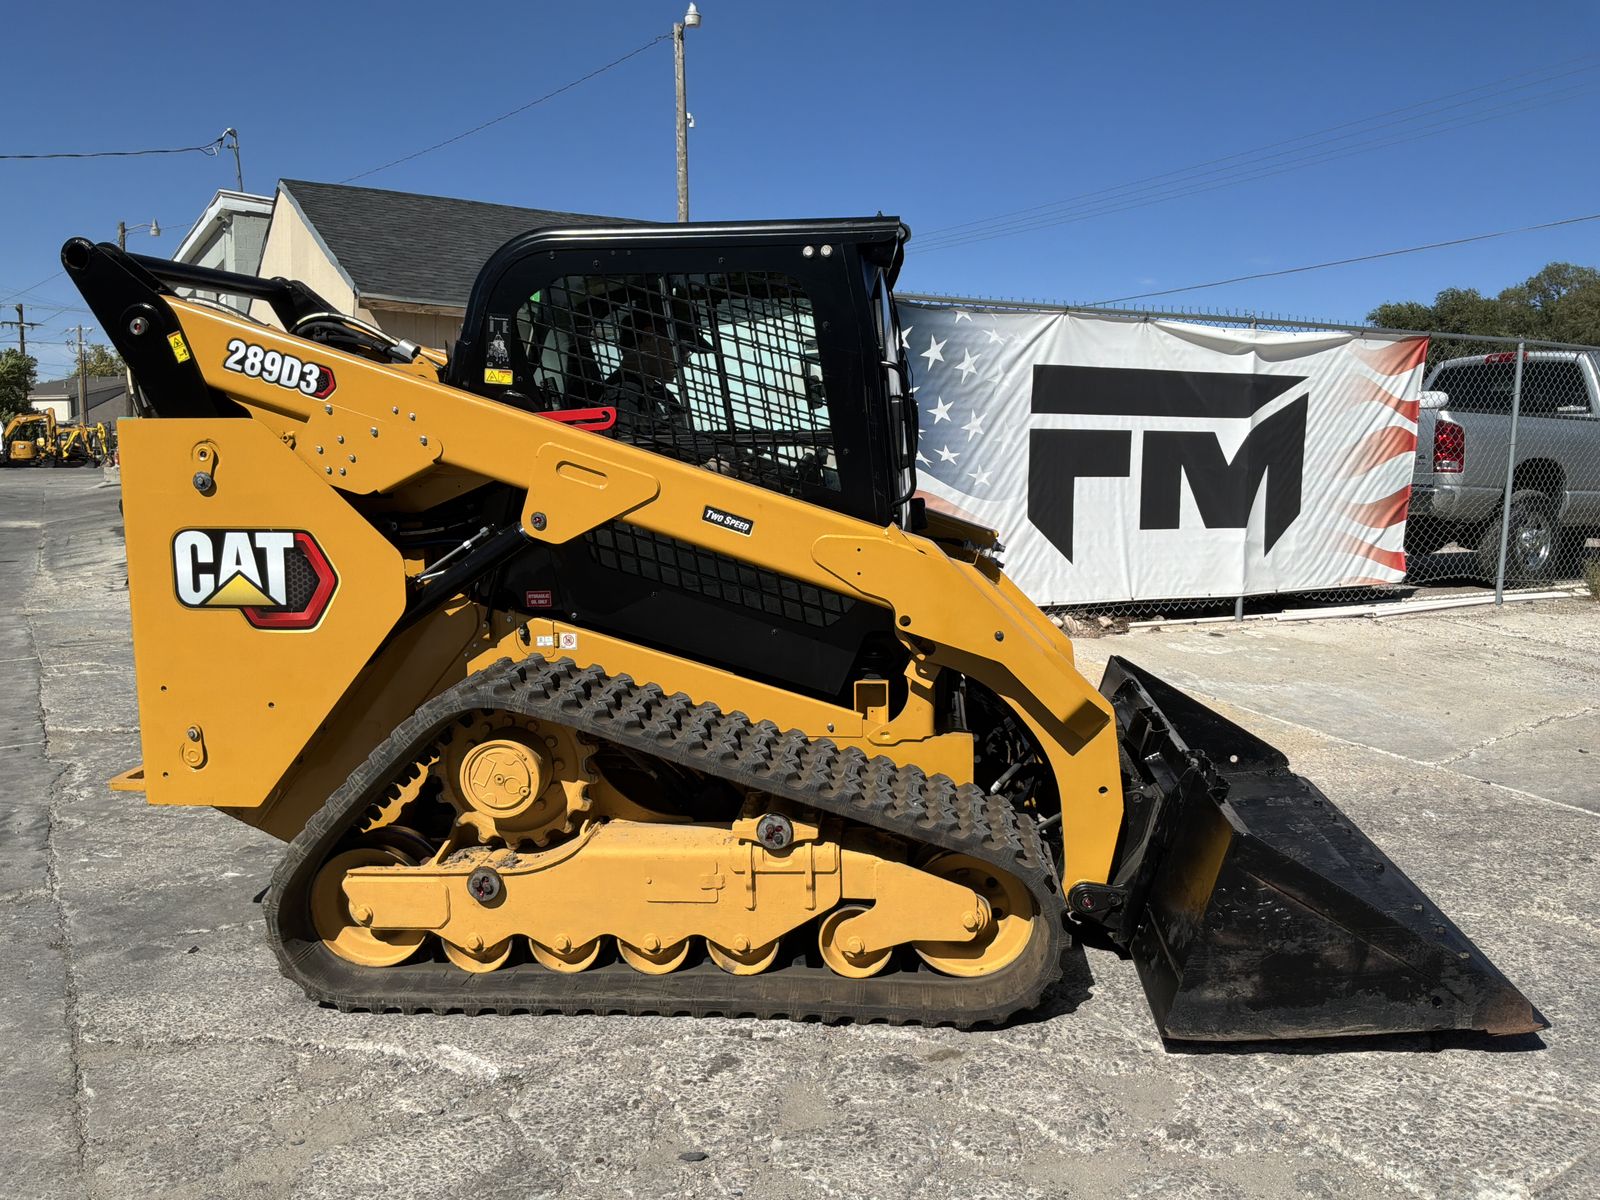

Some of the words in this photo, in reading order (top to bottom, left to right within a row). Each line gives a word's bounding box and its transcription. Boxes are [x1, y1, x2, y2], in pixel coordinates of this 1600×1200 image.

[224, 339, 320, 394] 289D3
[1027, 364, 1310, 565] FM
[724, 516, 750, 530] SPEED
[174, 530, 294, 606] CAT
